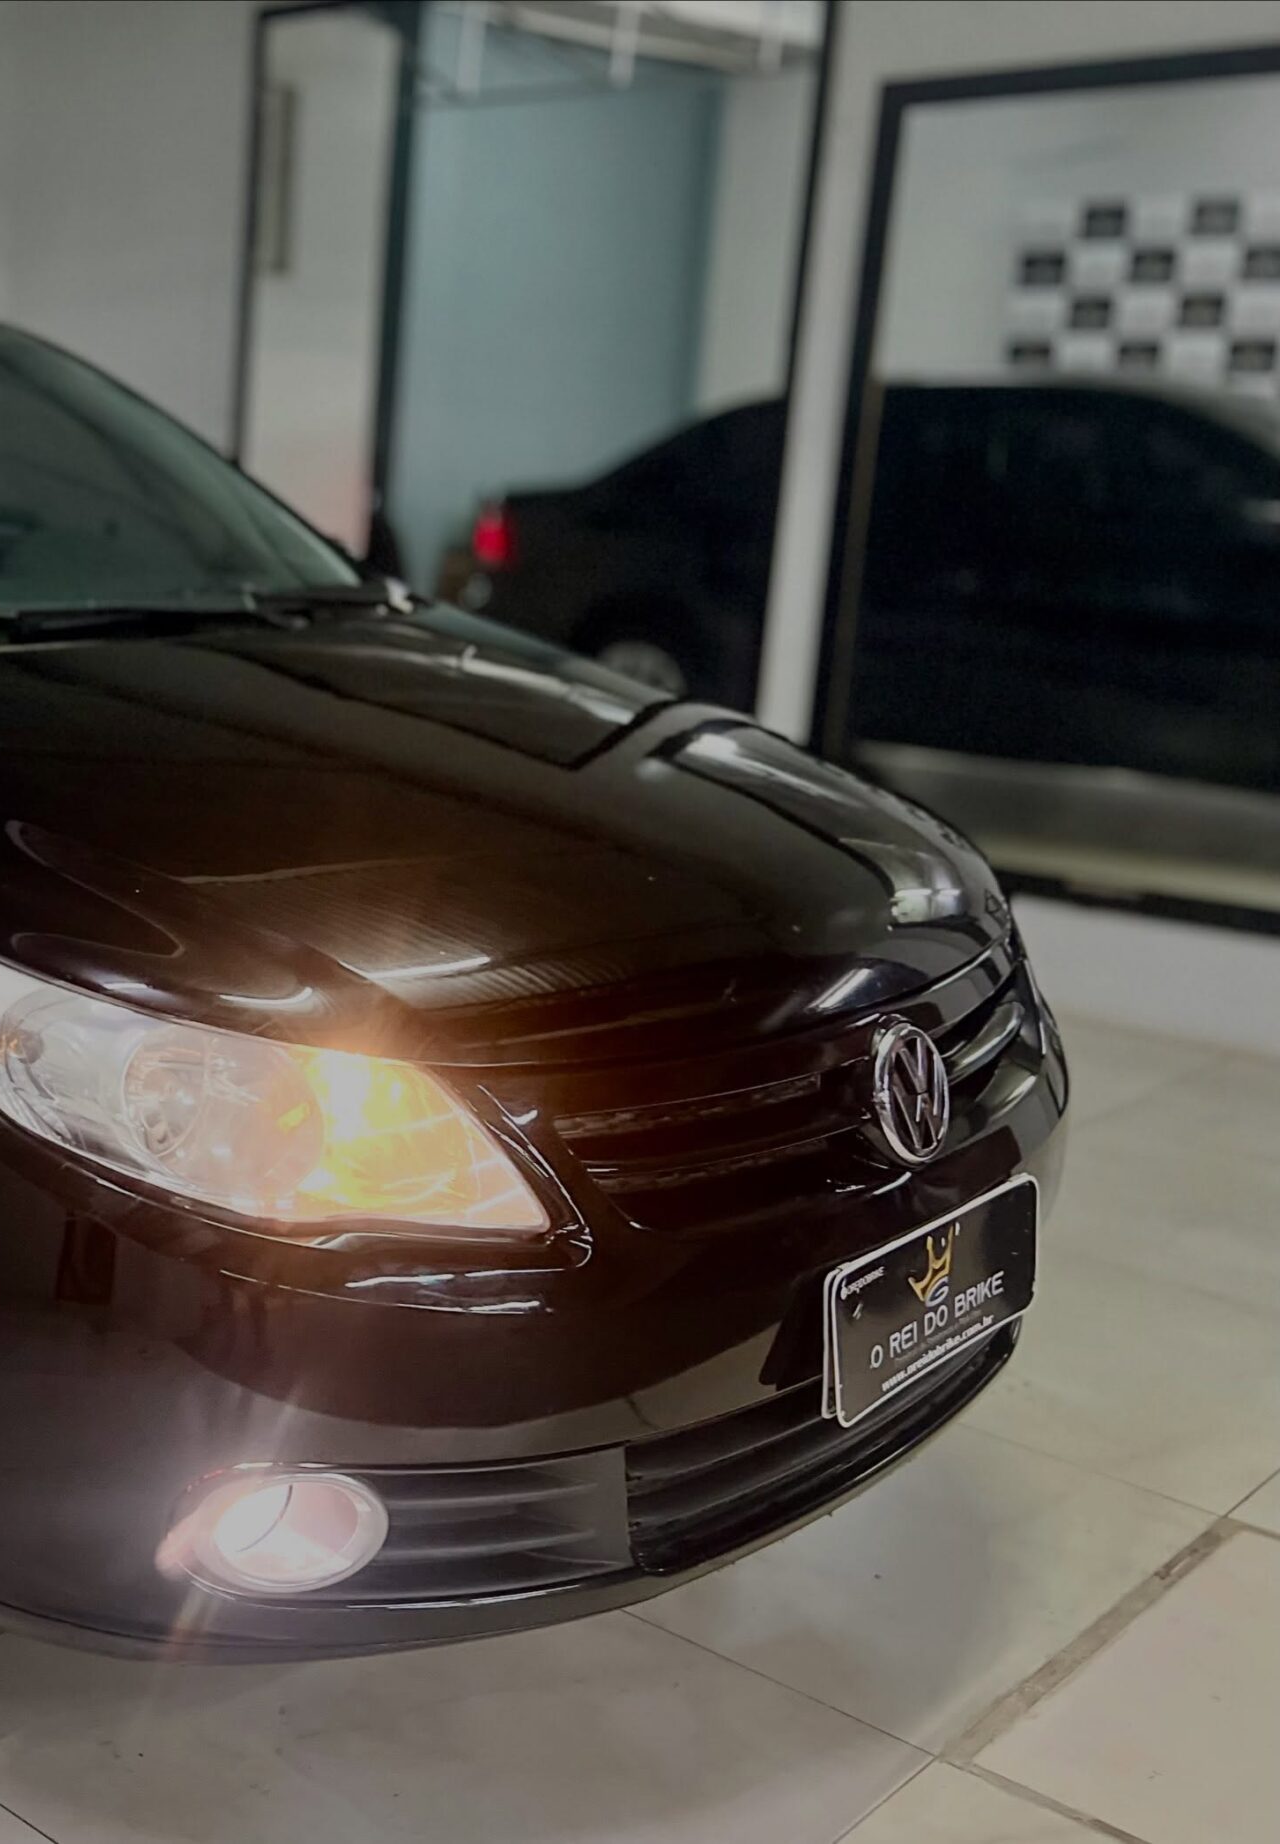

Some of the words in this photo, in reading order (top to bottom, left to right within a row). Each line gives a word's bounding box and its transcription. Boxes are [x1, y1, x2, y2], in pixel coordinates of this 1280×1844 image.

[871, 1344, 884, 1368] O
[889, 1321, 918, 1358] REI
[924, 1304, 949, 1337] DO
[954, 1271, 1005, 1318] BRIKE
